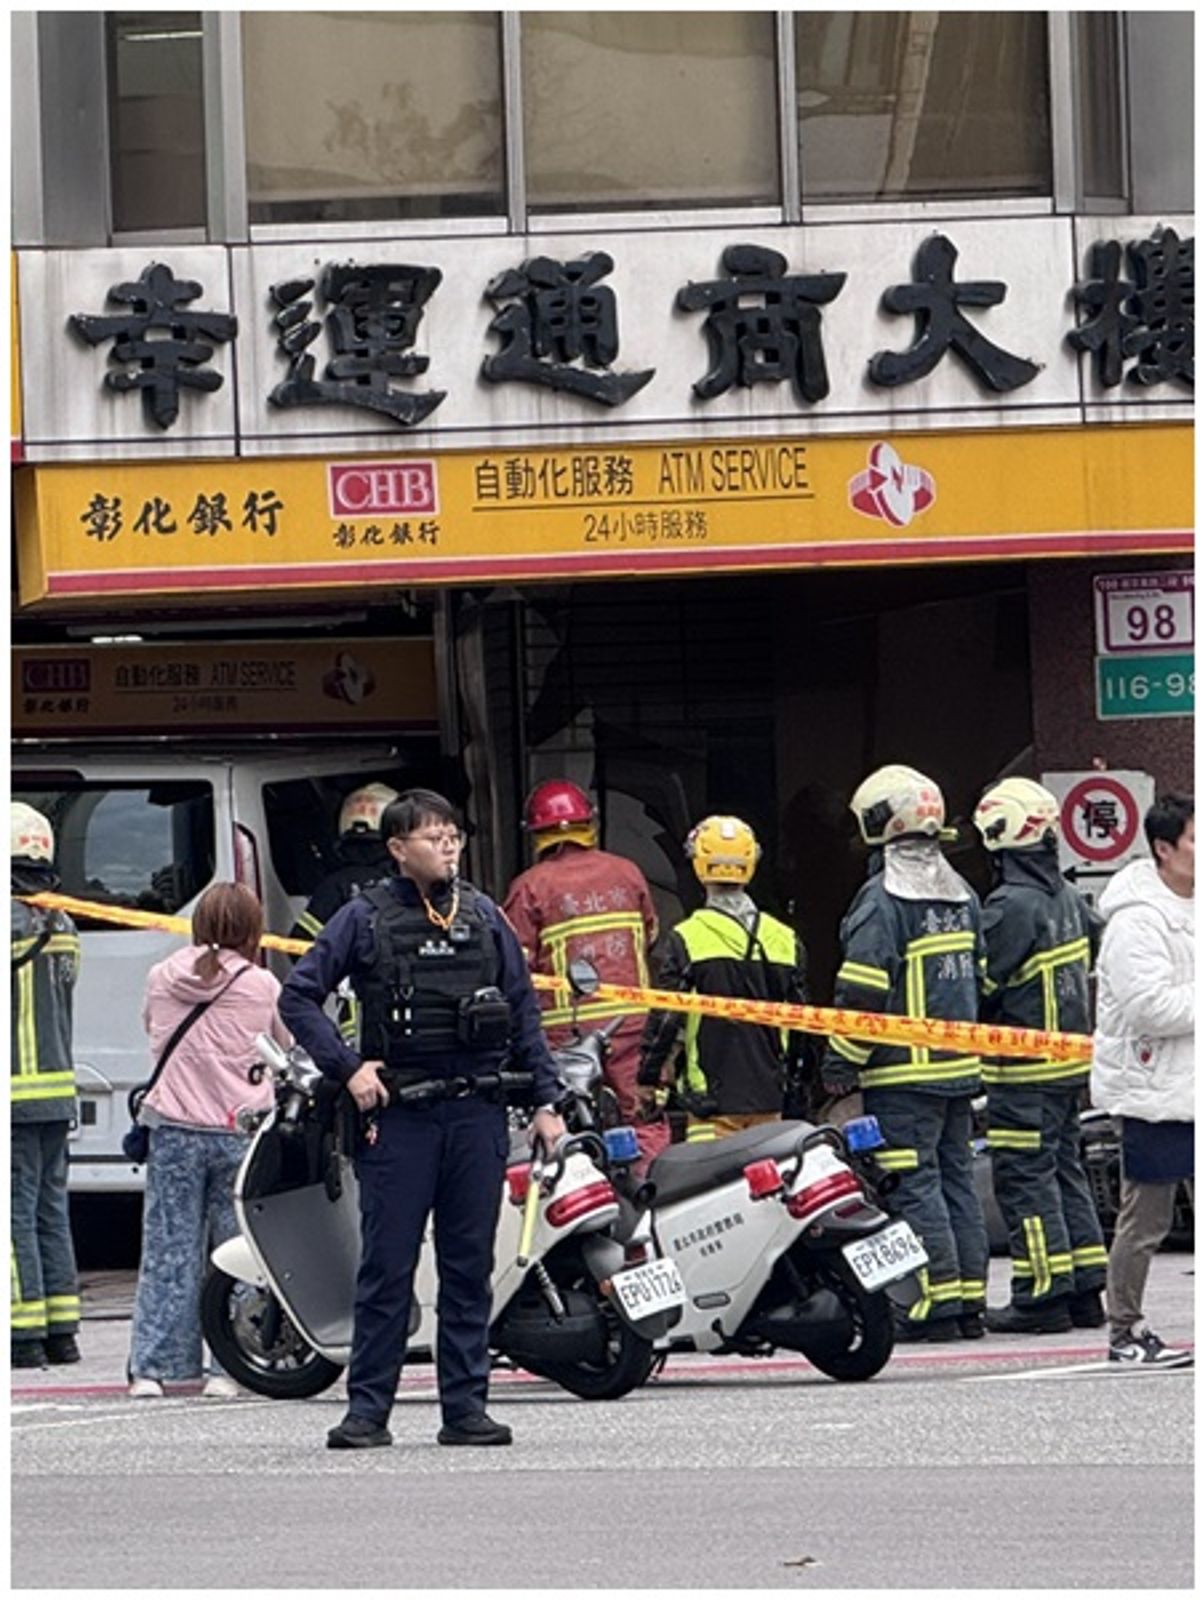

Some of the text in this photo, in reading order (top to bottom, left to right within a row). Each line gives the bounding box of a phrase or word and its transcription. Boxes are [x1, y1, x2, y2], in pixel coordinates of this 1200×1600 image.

[69, 227, 1194, 429] 幸運通商大樓
[335, 467, 432, 512] CHB
[474, 446, 809, 500] 自動化服務 ATM SERVICE
[80, 490, 285, 543] 彰化銀行
[332, 520, 440, 549] 彰化銀行
[583, 509, 708, 543] 24小時服務
[1127, 604, 1176, 641] 98
[24, 660, 88, 690] CHB
[1082, 800, 1118, 839] 停
